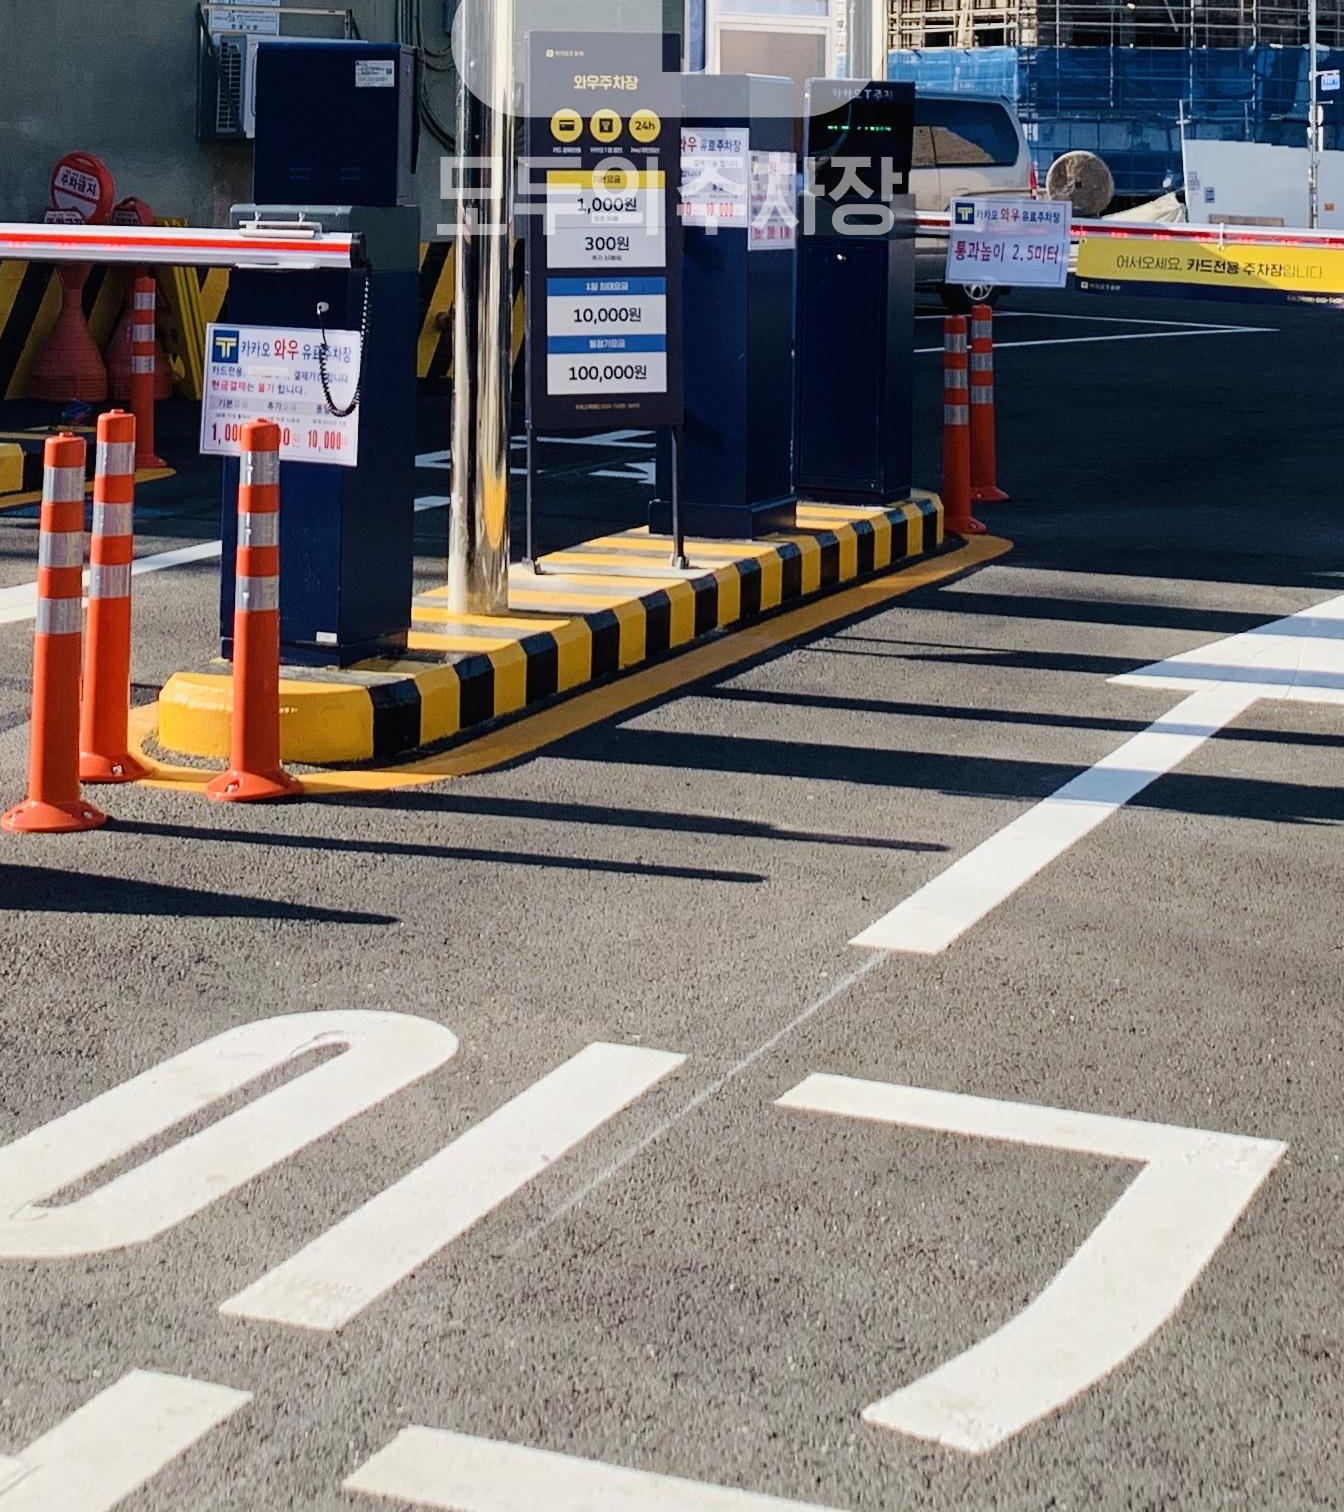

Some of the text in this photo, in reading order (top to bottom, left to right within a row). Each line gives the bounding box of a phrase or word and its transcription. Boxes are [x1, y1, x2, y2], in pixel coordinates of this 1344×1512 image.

[573, 74, 638, 90] 와우주차장
[634, 120, 655, 131] 24h
[700, 139, 741, 153] 유료주차장
[60, 172, 96, 196] 주차금지
[577, 197, 637, 214] 1,000원
[1000, 208, 1020, 222] 와우
[585, 236, 630, 251] 300원
[955, 240, 1058, 264] 통과높이 2.5미터
[1116, 254, 1182, 271] 어서오세요,
[1186, 258, 1239, 274] 카드전용
[574, 308, 641, 324] 10,000원
[241, 340, 270, 357] 카카오
[274, 339, 299, 360] 와우
[569, 365, 647, 382] 100,000원
